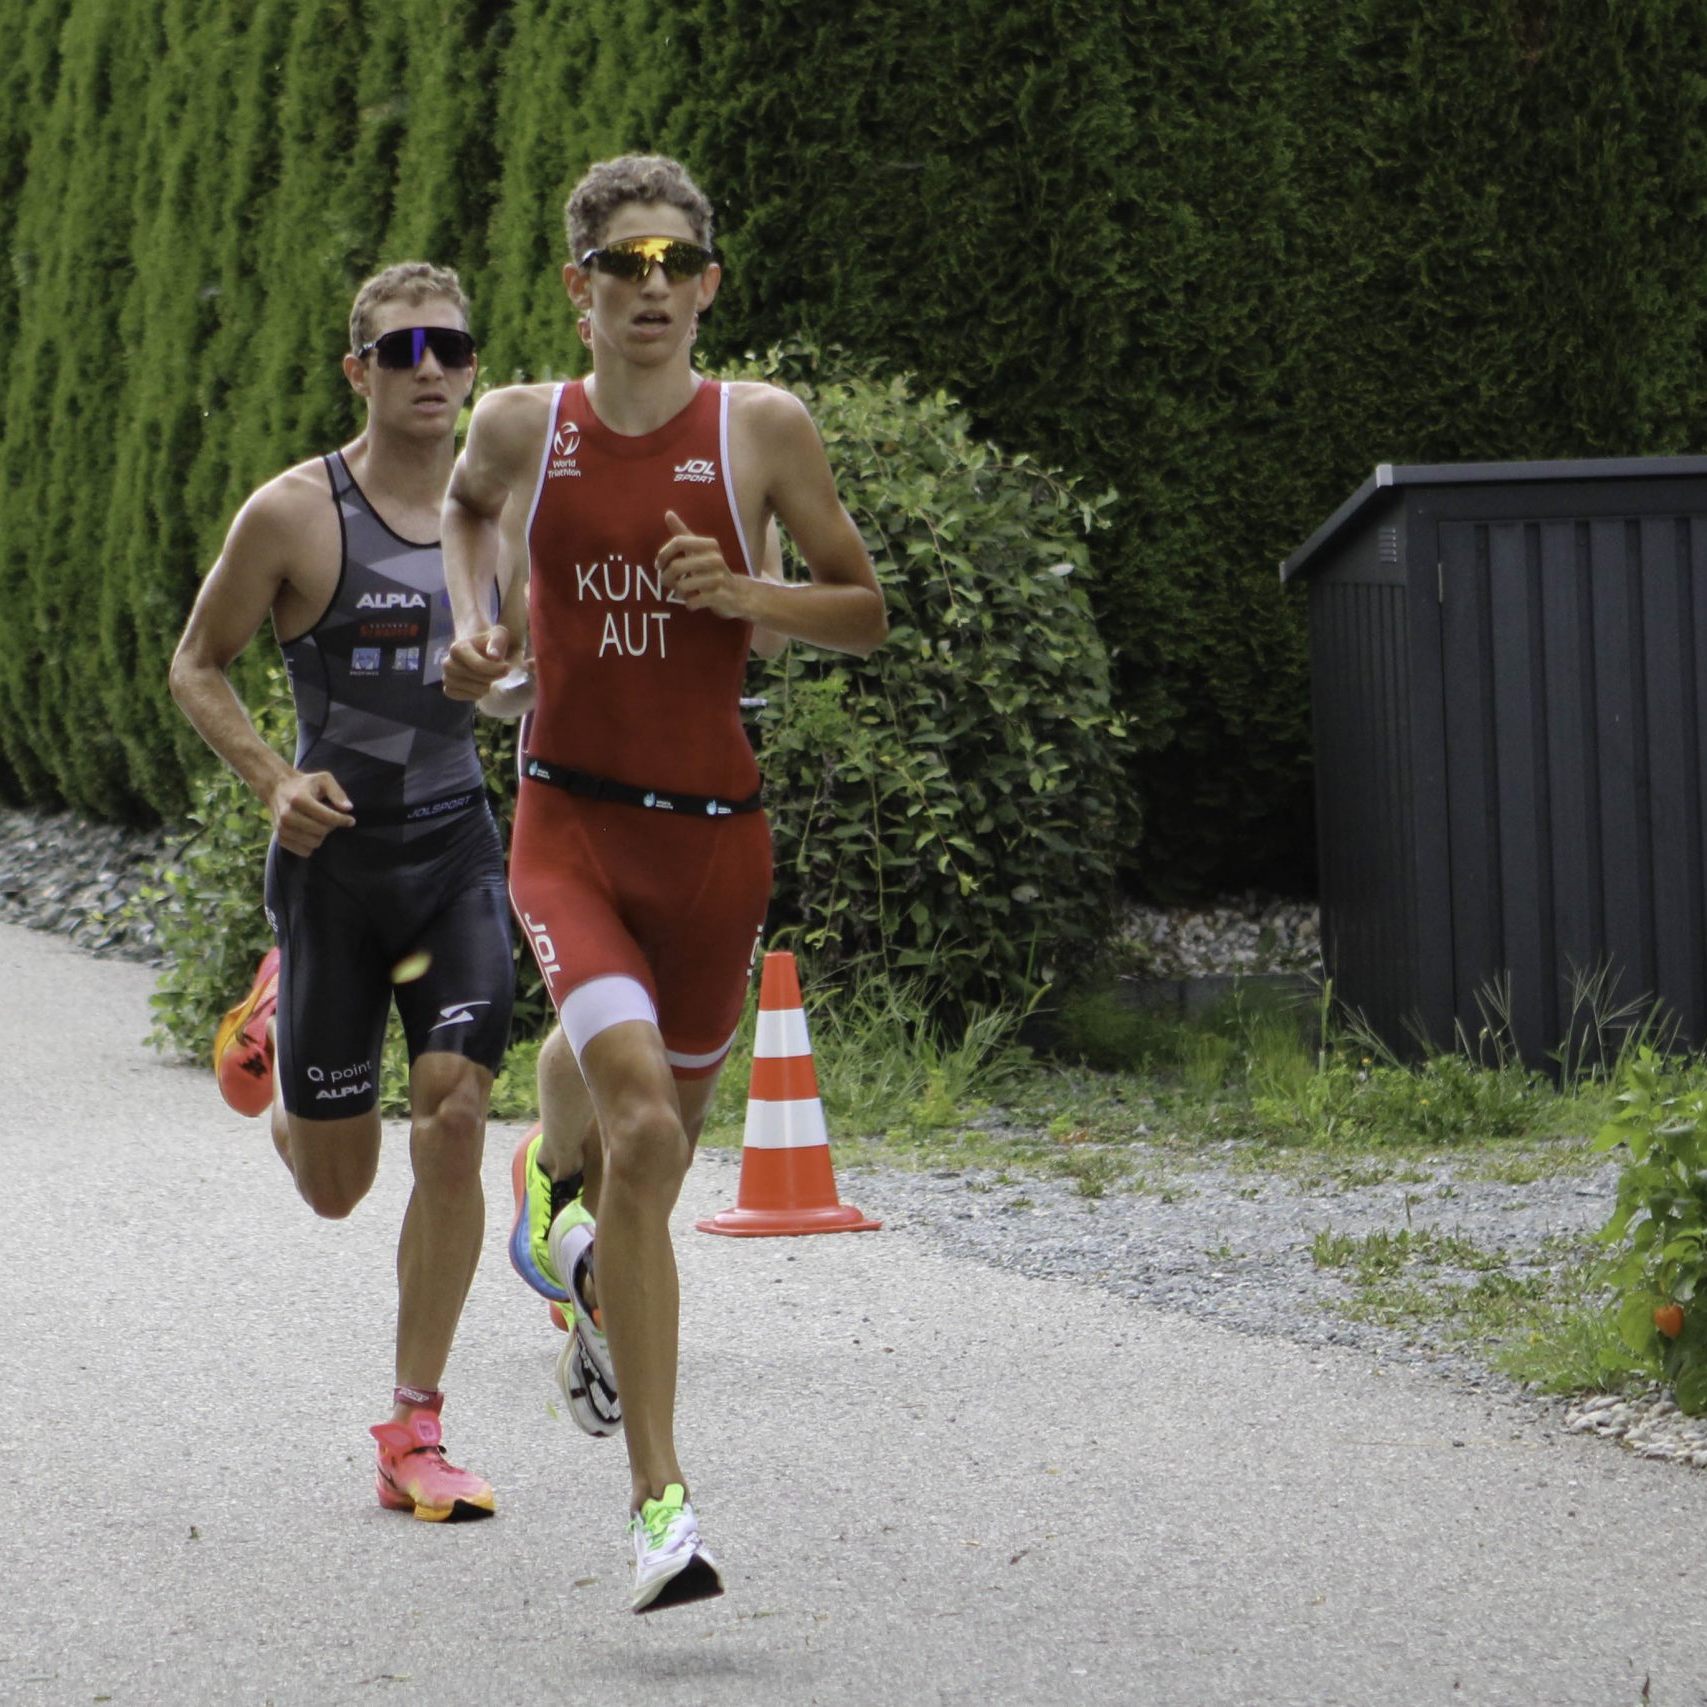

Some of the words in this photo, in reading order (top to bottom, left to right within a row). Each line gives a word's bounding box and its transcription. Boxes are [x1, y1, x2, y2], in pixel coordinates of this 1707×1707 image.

[552, 459, 576, 468] World
[674, 459, 716, 476] JOL
[548, 469, 582, 479] Triathlon
[673, 474, 716, 484] SPORT
[356, 592, 426, 609] ALPLA
[598, 612, 672, 659] AUT
[524, 912, 561, 988] JOL
[315, 1081, 372, 1100] ALPLA
